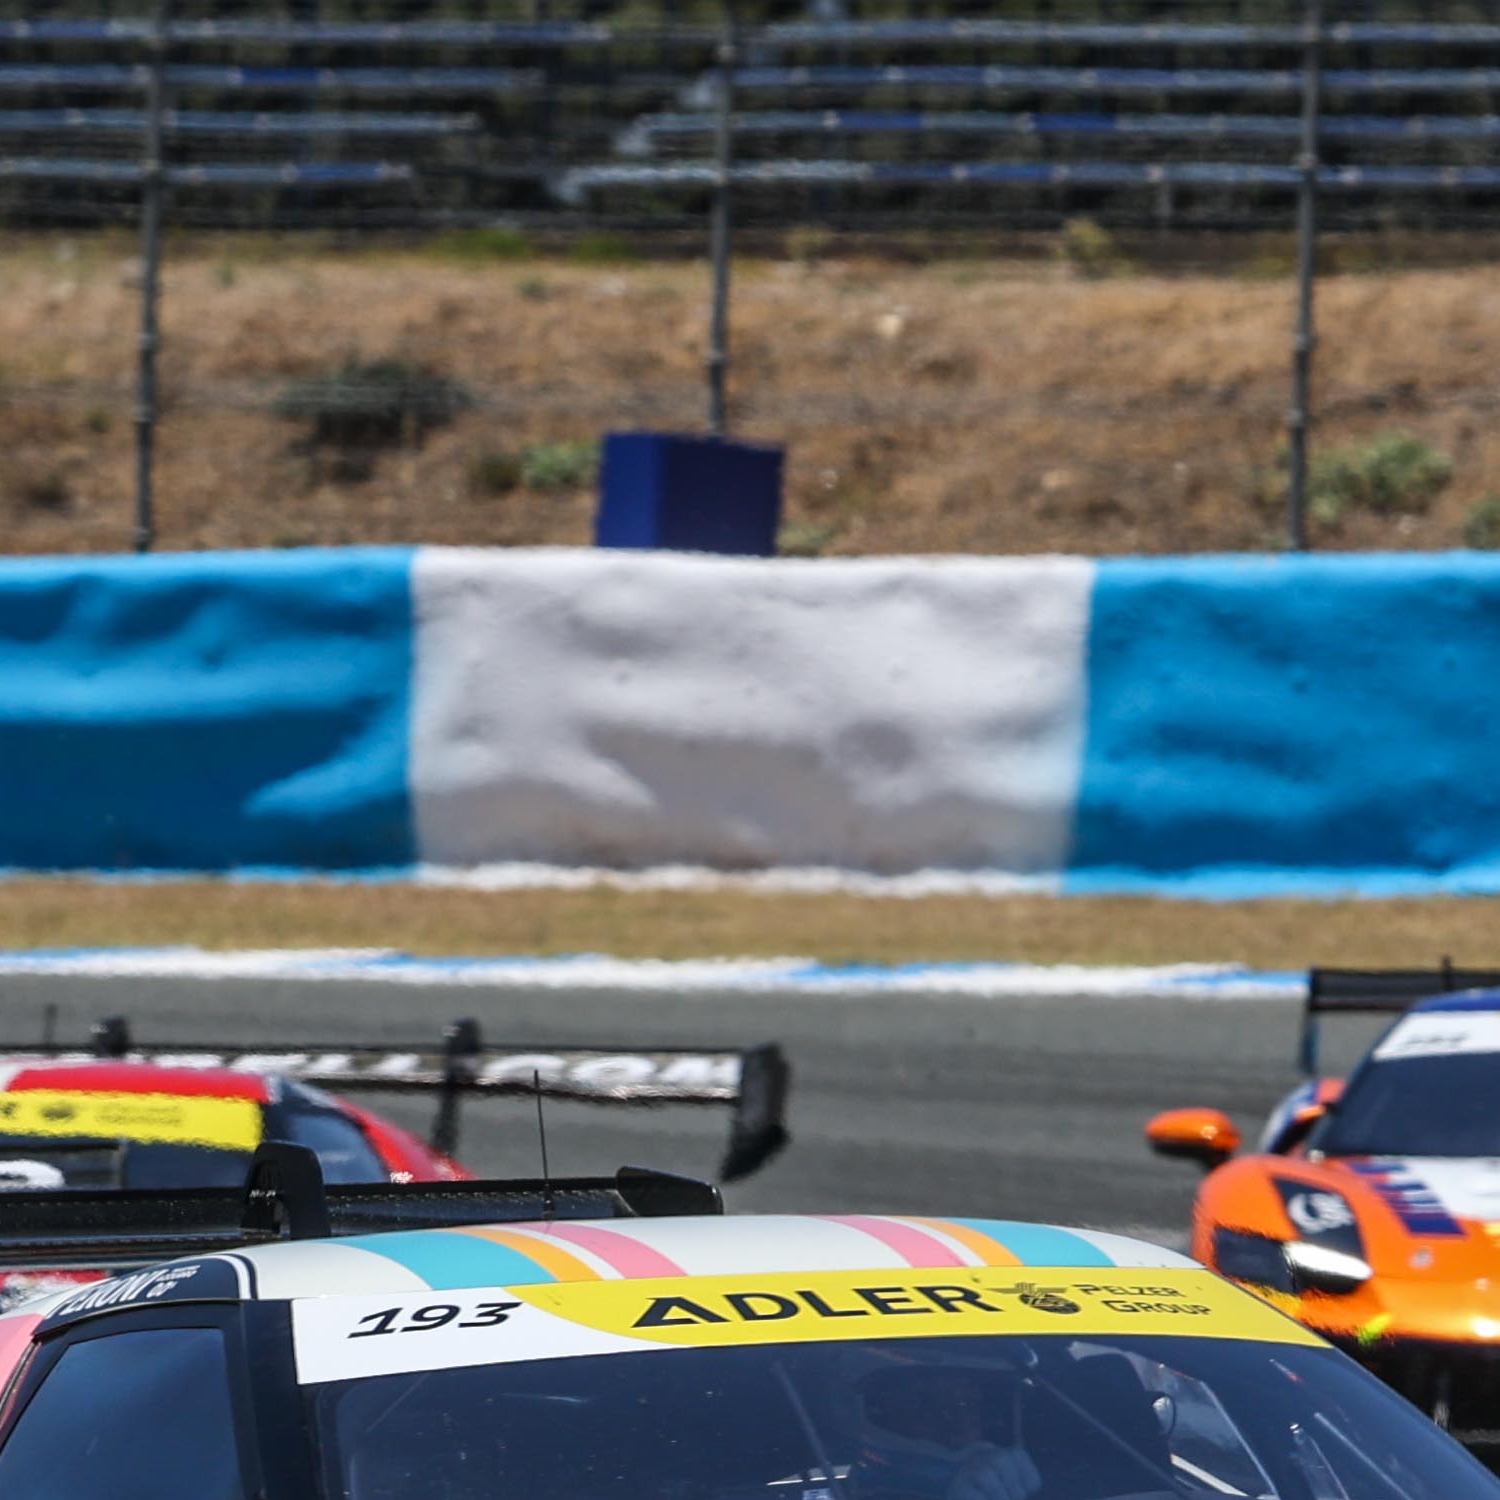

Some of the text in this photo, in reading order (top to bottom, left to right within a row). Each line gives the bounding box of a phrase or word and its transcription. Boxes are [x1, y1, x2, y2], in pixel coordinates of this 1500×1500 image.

[1073, 1283, 1187, 1299] PELZER
[347, 1301, 525, 1339] 193
[631, 1285, 1006, 1328] ADLER
[1102, 1299, 1212, 1316] GROUP
